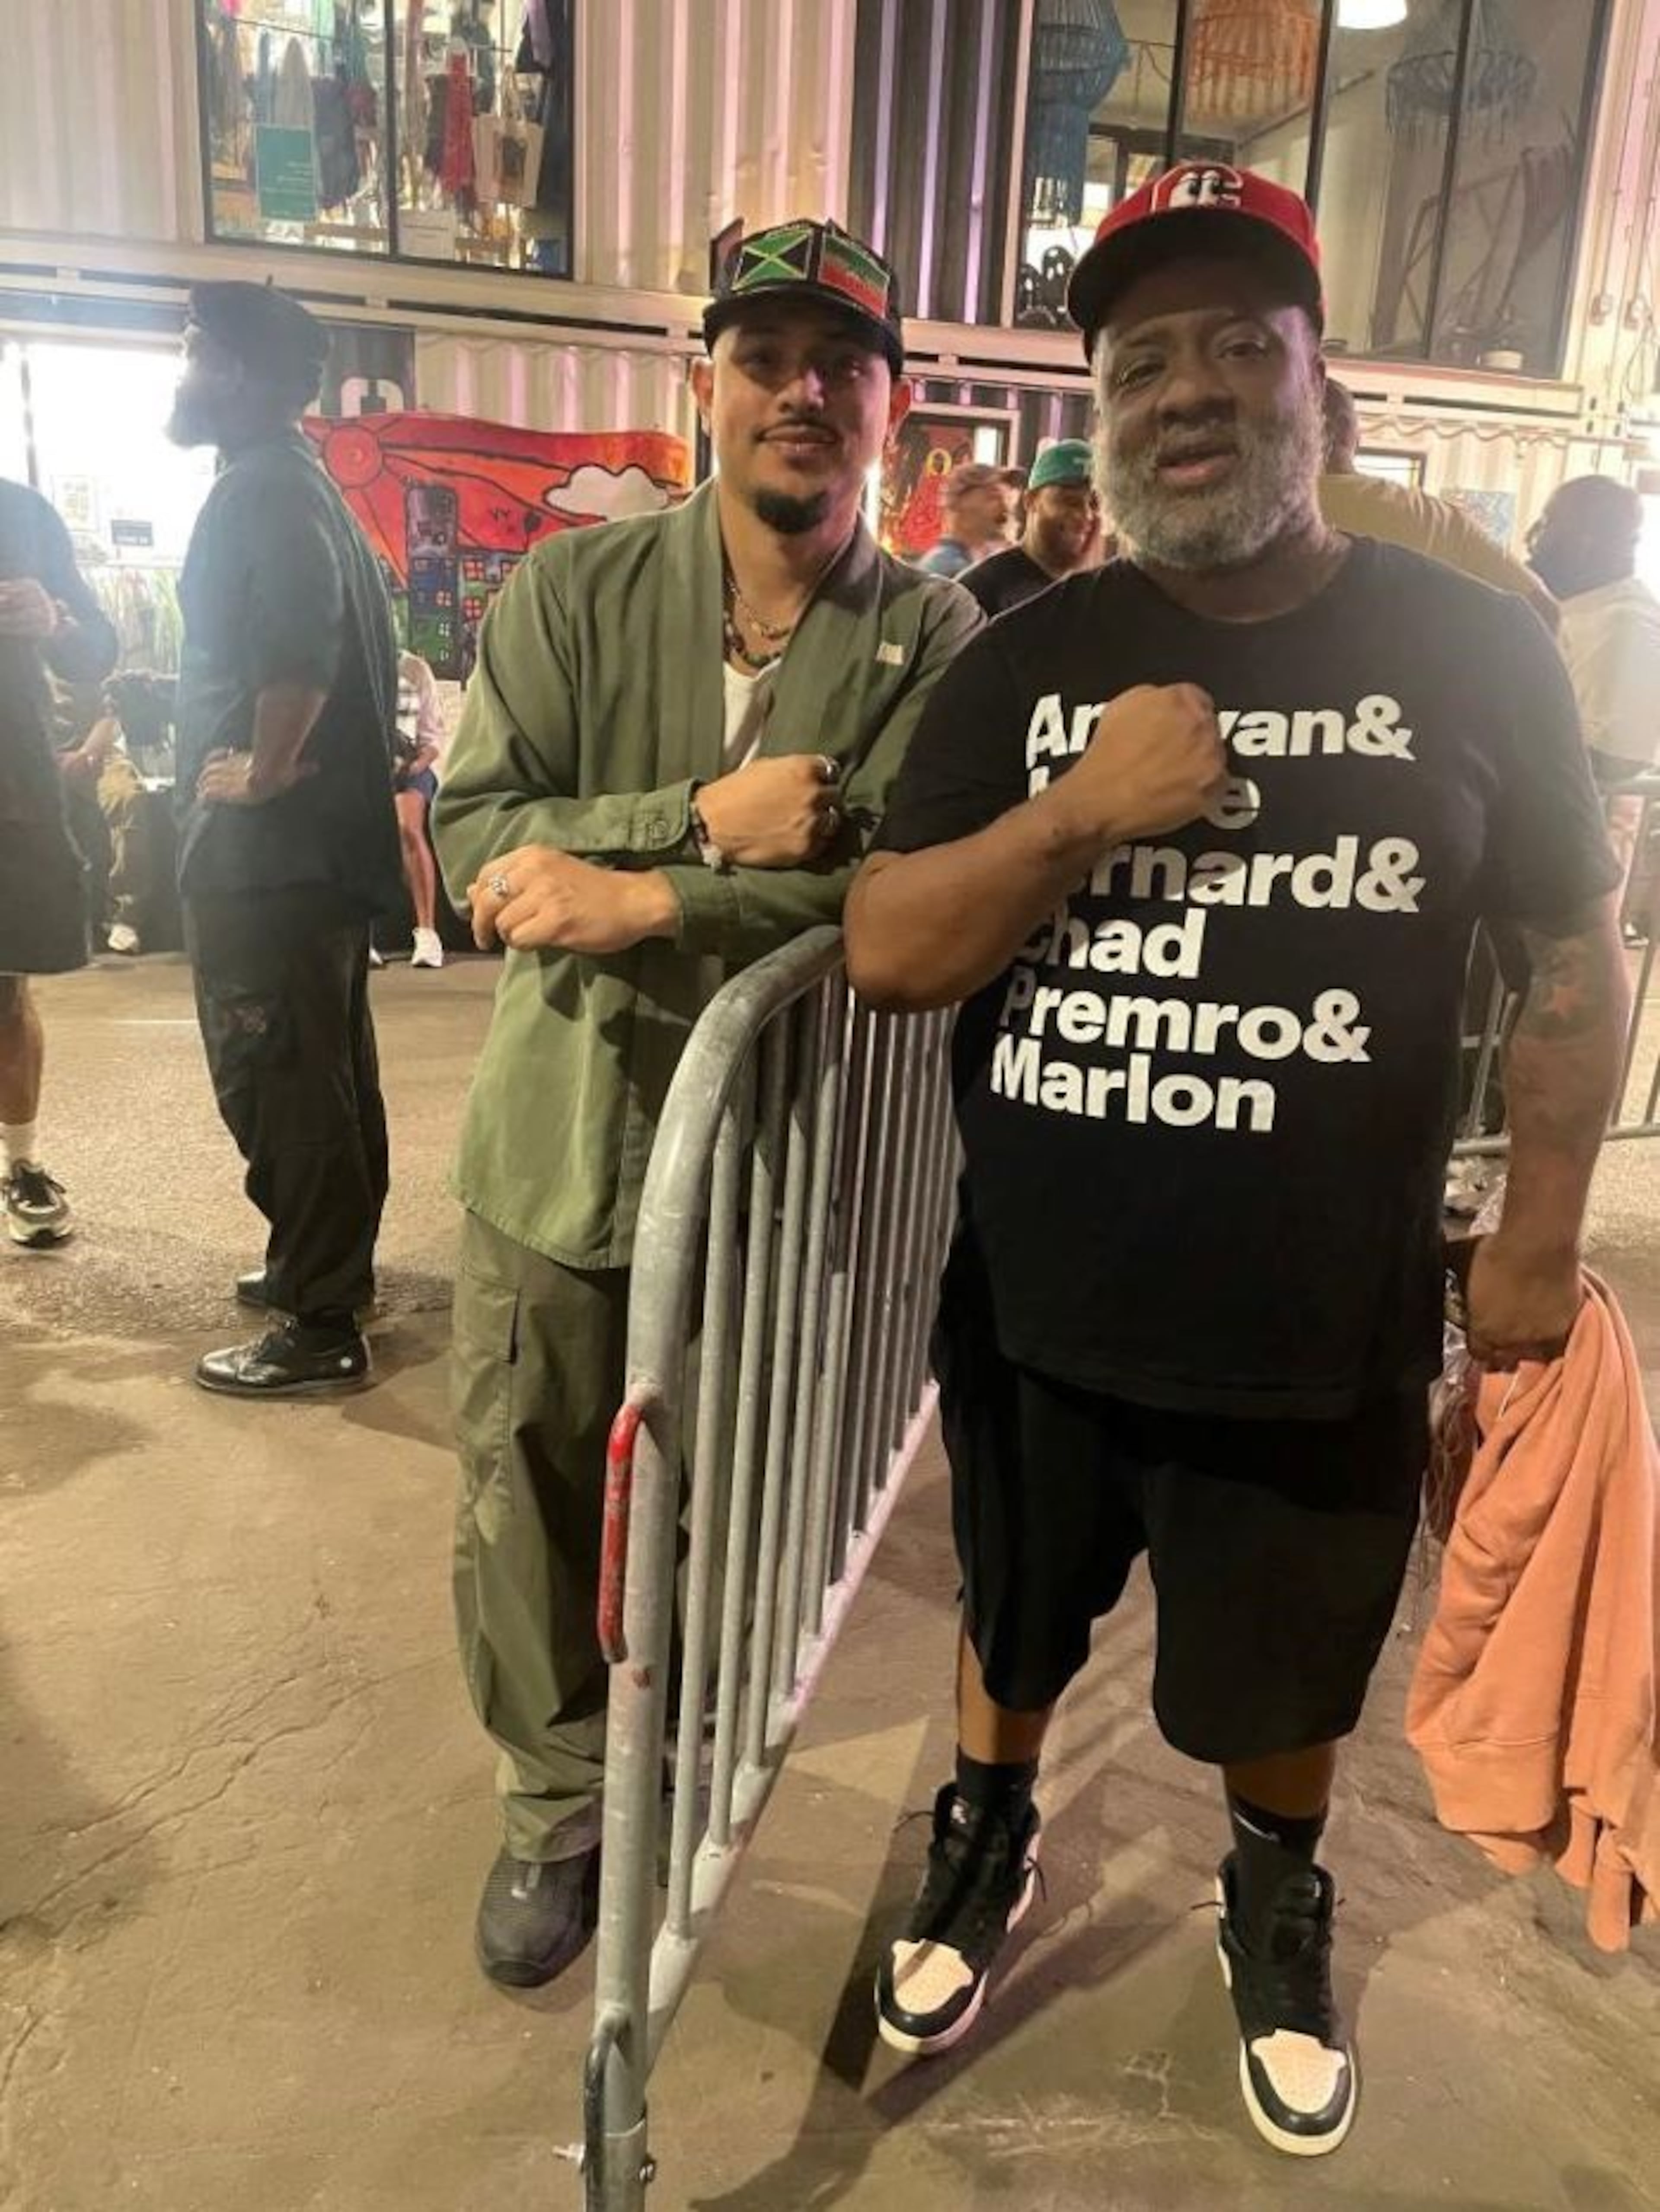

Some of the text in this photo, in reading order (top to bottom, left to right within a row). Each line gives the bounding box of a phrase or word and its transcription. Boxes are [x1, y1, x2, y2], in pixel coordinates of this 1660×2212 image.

[1025, 693, 1416, 770] Anan&
[1069, 835, 1426, 913] rnard&
[1000, 965, 1372, 1063] Premro&
[990, 1033, 1277, 1132] Marlon
